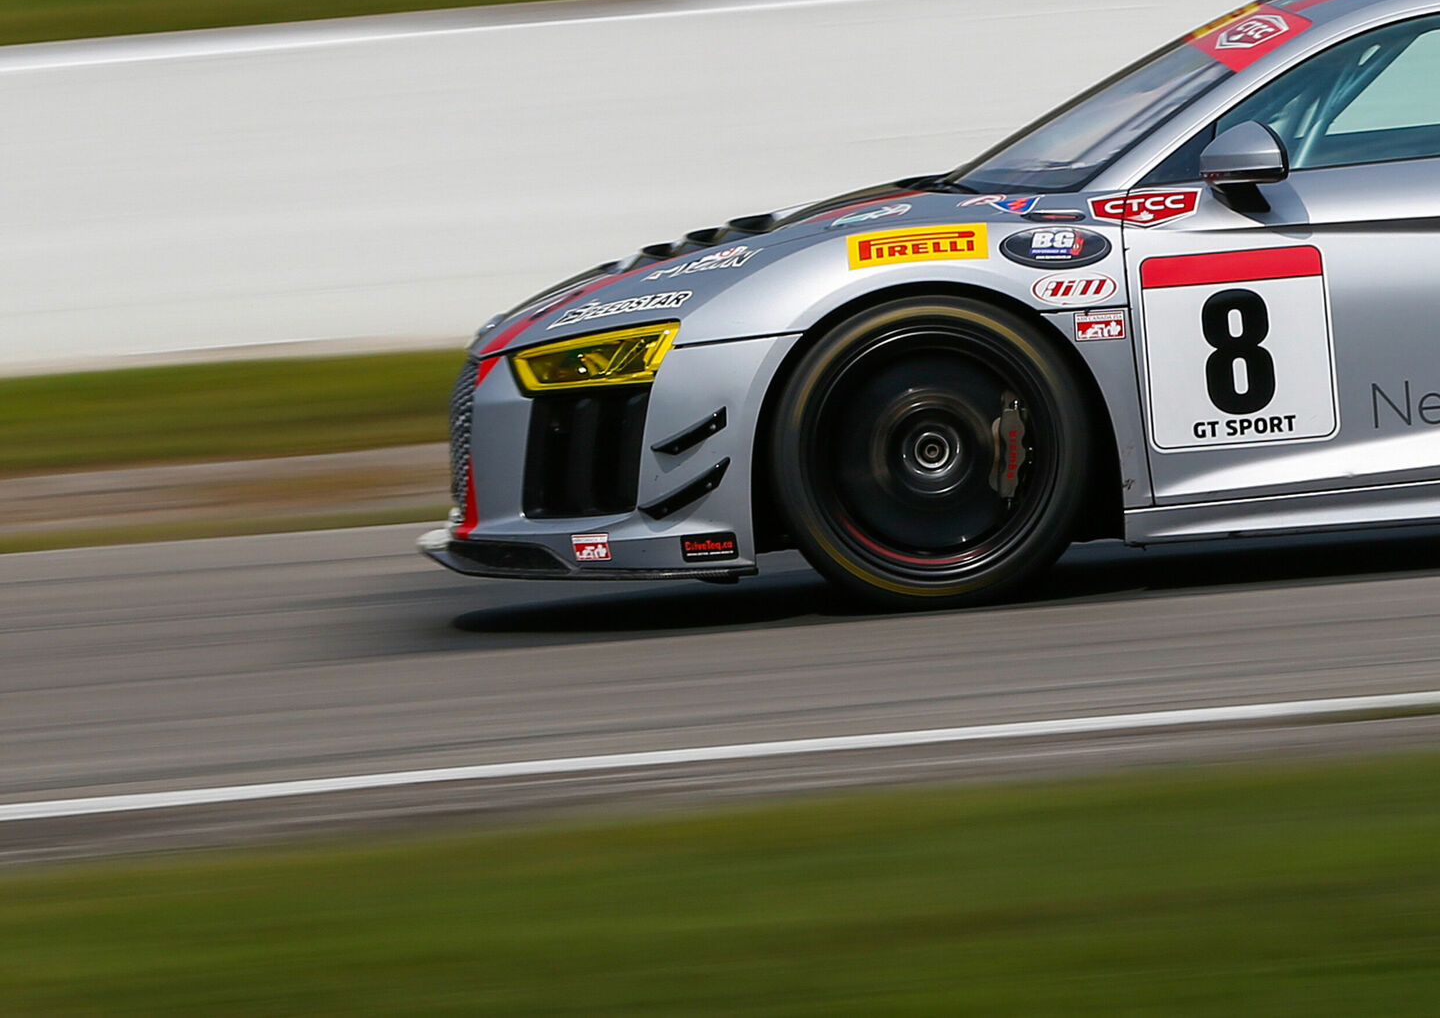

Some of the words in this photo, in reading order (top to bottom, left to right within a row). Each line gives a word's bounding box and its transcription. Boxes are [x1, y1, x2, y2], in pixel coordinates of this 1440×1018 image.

[1104, 195, 1185, 214] CTCC
[858, 231, 976, 261] PIRELLI
[1031, 231, 1075, 248] BG
[546, 290, 694, 331] SPEEDSTAR
[1202, 288, 1276, 415] 8
[1193, 421, 1219, 438] GT
[1226, 415, 1296, 436] SPORT
